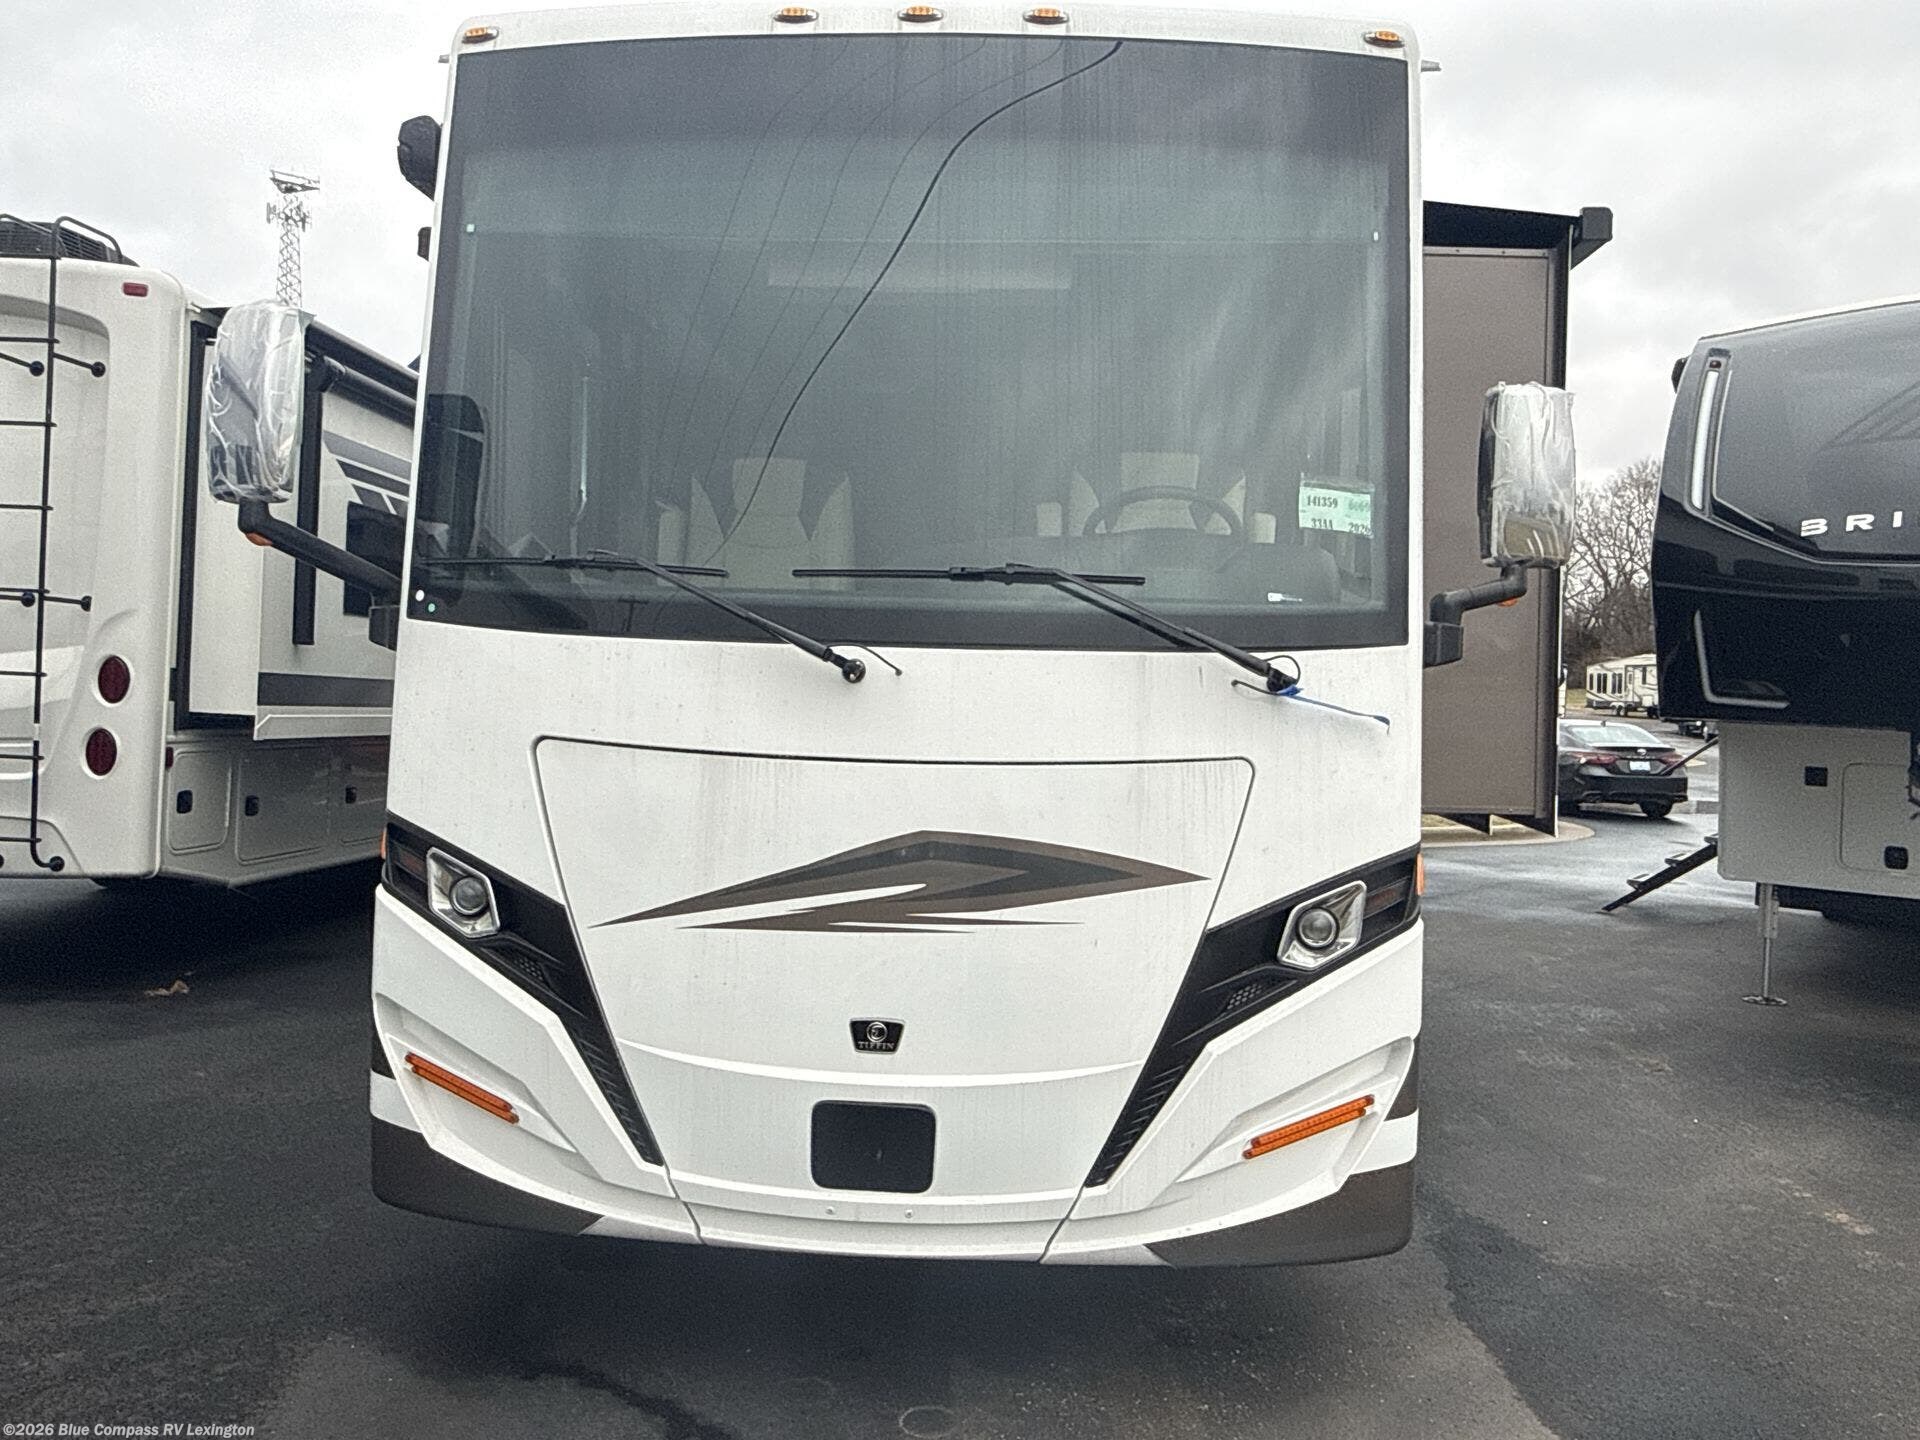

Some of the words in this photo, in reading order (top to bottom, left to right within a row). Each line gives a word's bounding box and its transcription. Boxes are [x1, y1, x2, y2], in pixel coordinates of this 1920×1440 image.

[1307, 495, 1338, 508] 141359
[1801, 511, 1903, 537] BRI
[858, 1041, 895, 1050] TIFFIN
